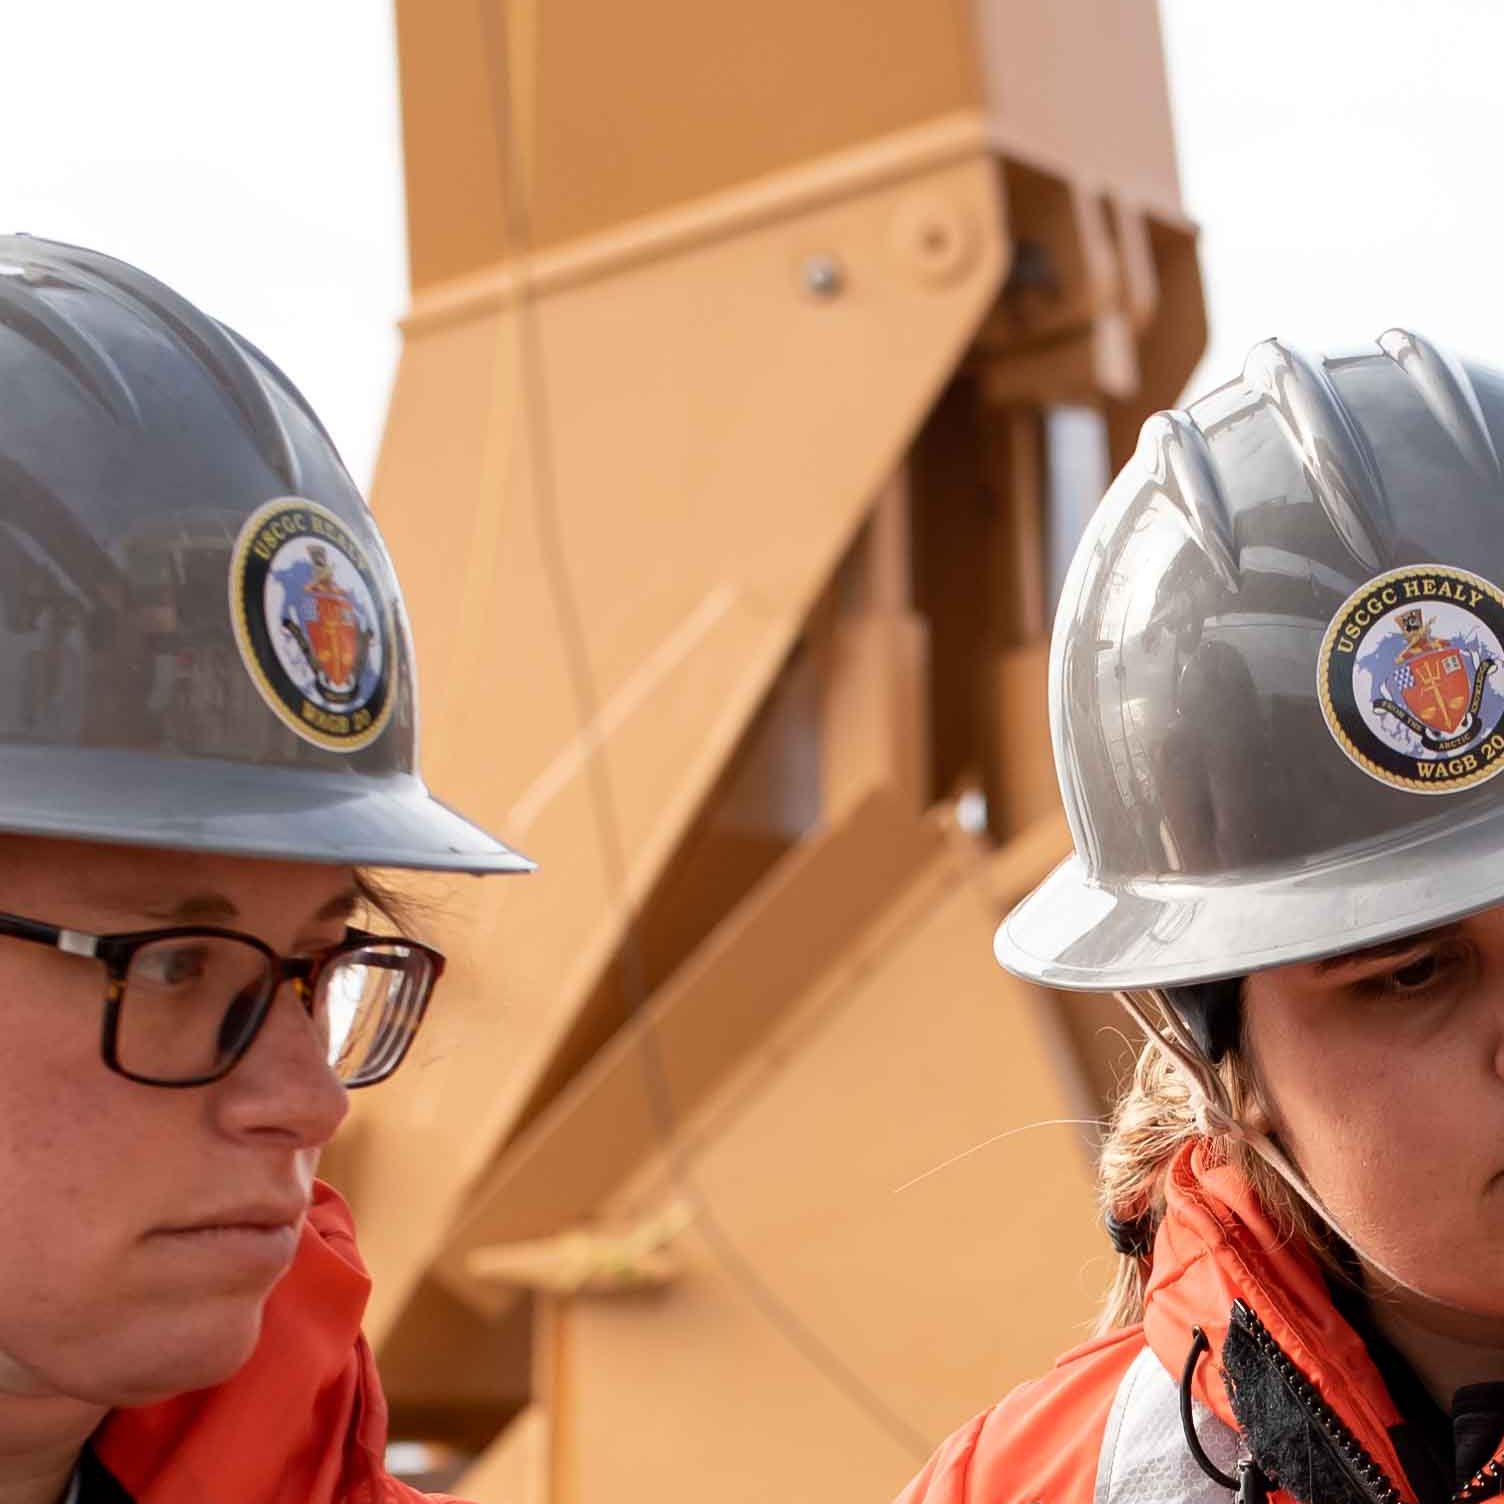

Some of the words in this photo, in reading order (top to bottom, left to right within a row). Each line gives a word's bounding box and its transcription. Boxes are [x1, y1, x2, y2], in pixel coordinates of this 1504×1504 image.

[1338, 588, 1397, 654] USCGC
[1403, 579, 1484, 608] HEALY
[1416, 754, 1478, 778] WAGB
[1481, 734, 1504, 760] 20
